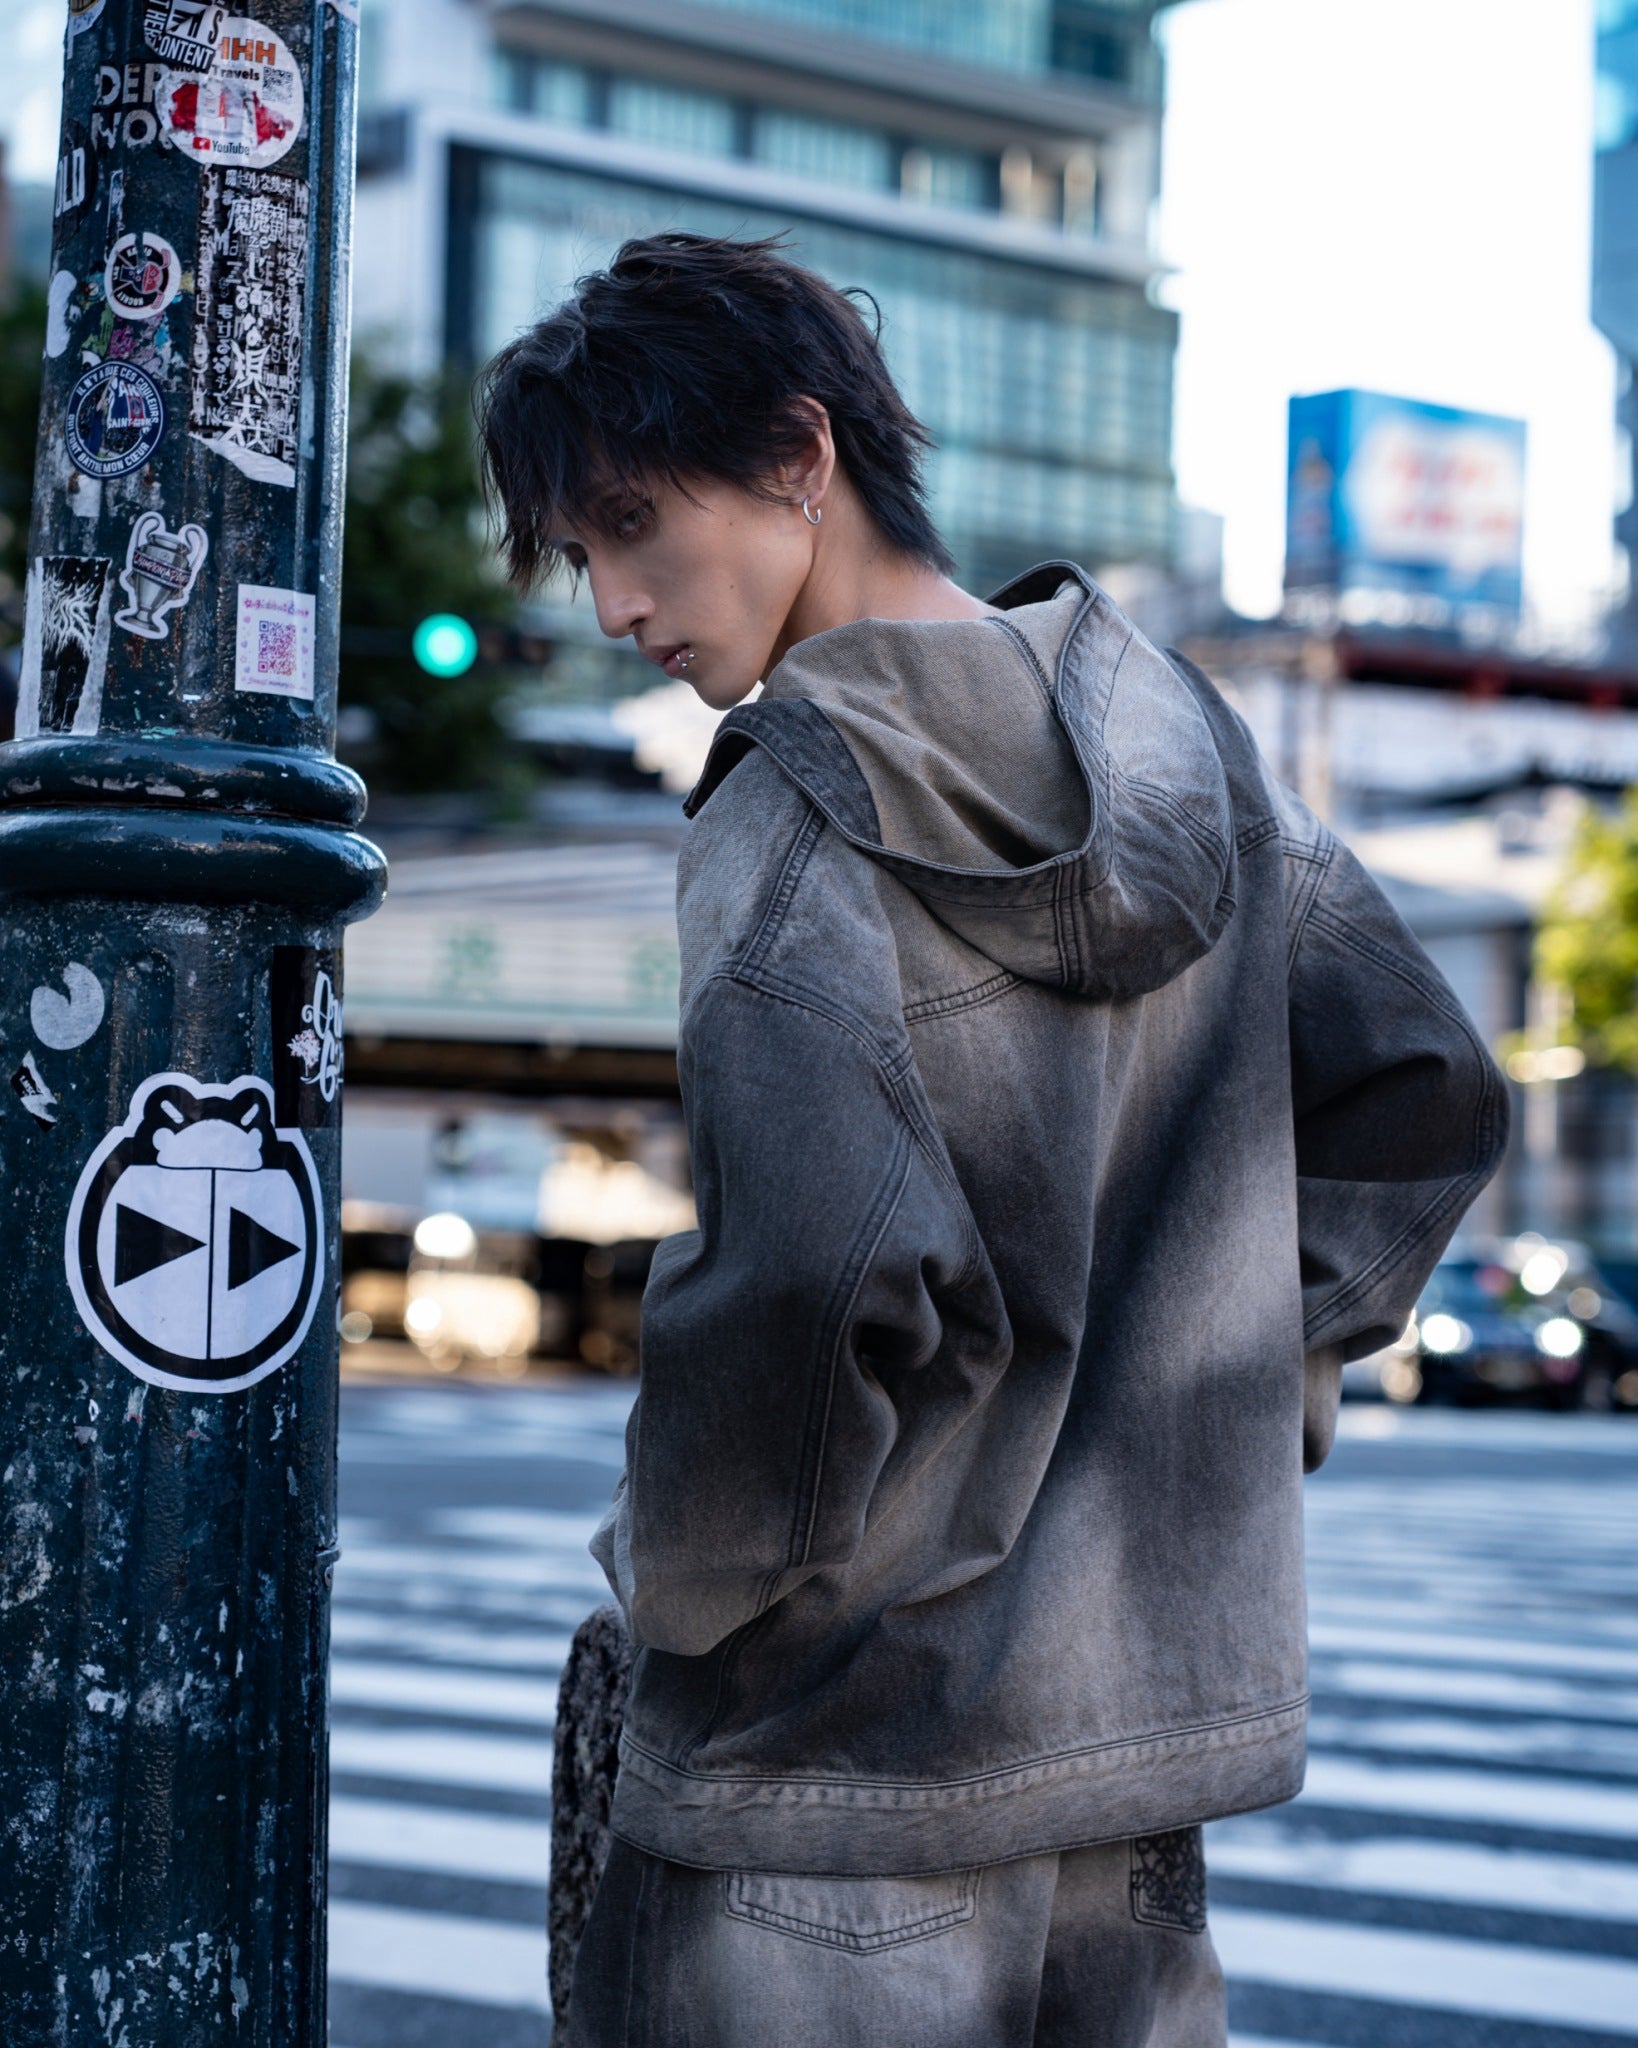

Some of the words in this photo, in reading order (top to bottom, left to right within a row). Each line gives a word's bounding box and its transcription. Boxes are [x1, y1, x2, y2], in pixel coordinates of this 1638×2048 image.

[154, 34, 214, 70] ONTENT
[212, 140, 250, 156] YouTube
[120, 366, 138, 382] CES
[135, 377, 160, 424] COULEURS
[102, 461, 124, 473] MON
